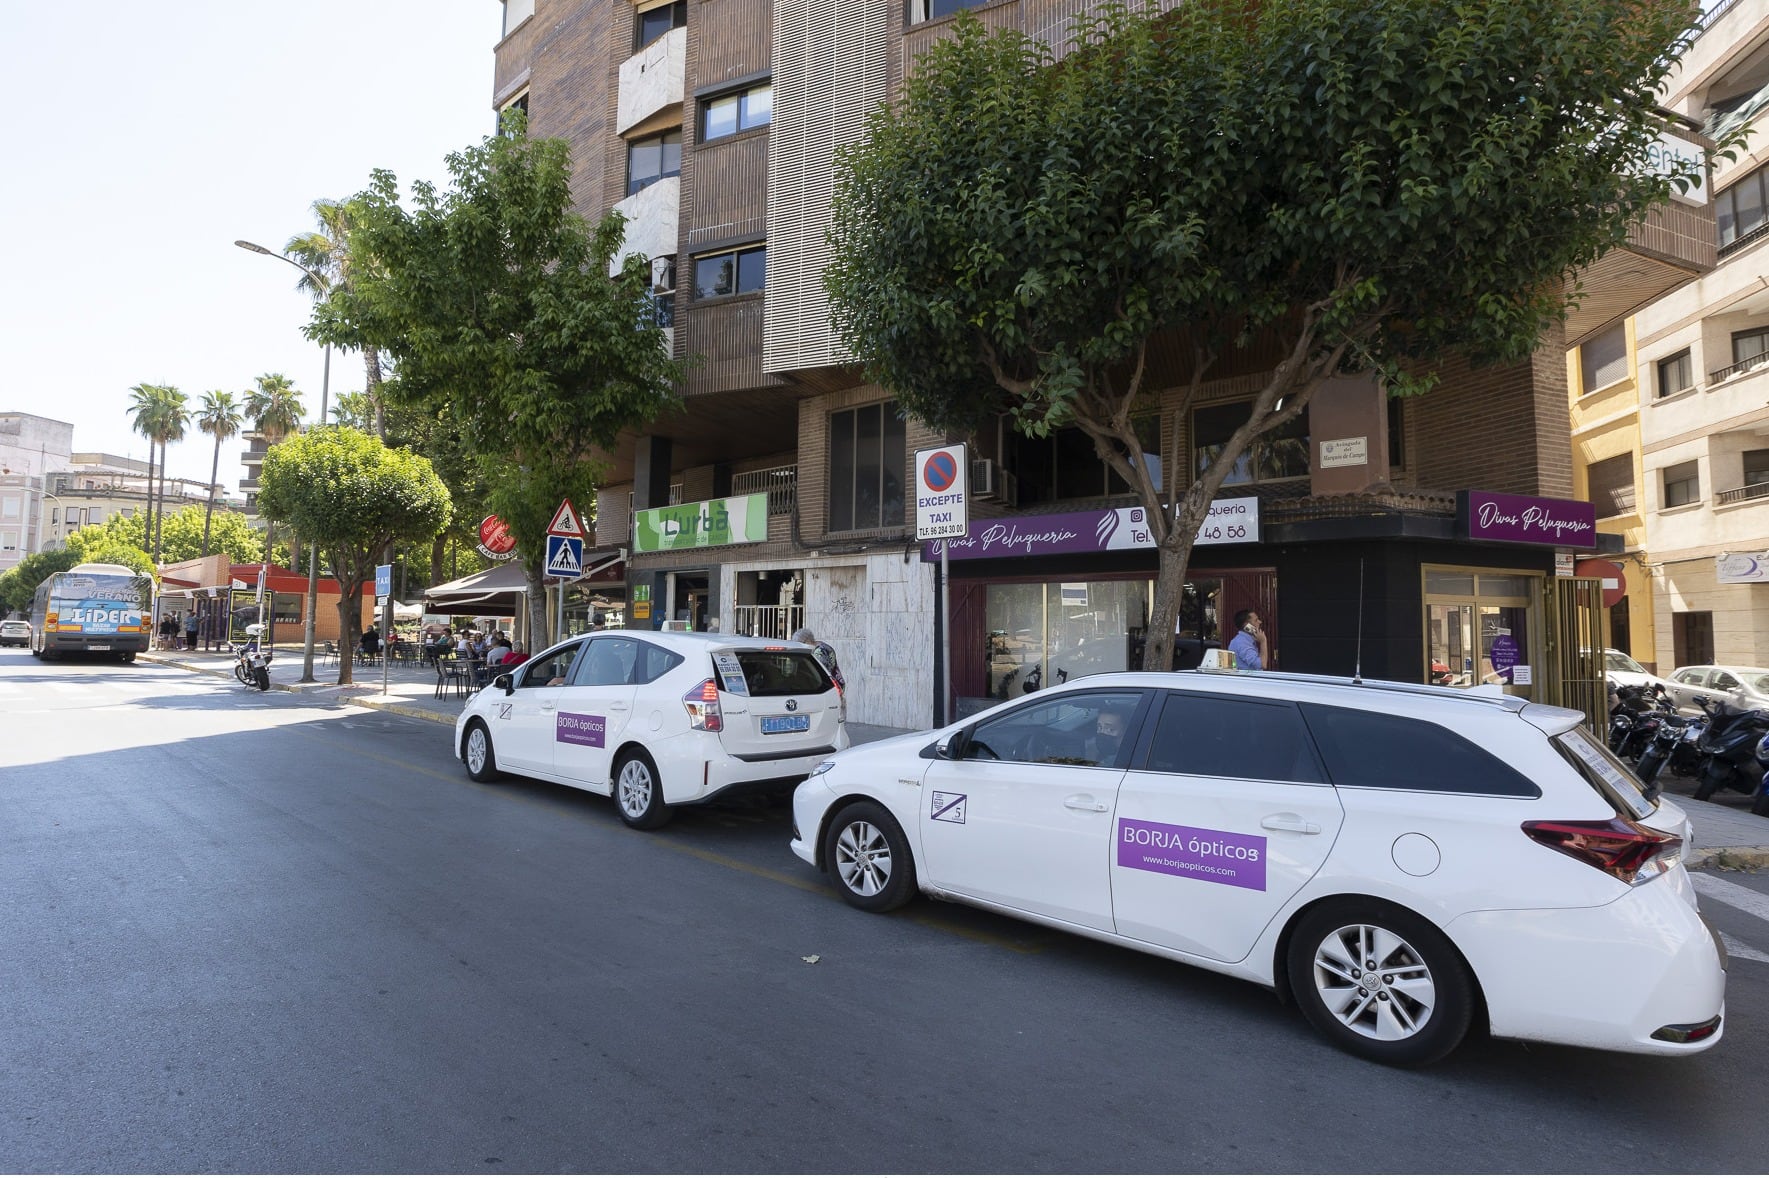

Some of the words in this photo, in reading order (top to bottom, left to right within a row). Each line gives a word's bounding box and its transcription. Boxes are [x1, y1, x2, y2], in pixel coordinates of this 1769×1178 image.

[1641, 144, 1699, 175] ental
[919, 493, 963, 508] EXCEPTE
[929, 512, 952, 523] TAXI
[1478, 502, 1519, 529] Divas
[930, 526, 937, 536] 96
[938, 525, 948, 535] 284
[949, 524, 956, 534] 30
[957, 524, 964, 533] 00
[1130, 529, 1150, 543] Tel.
[1204, 526, 1222, 539] 48
[1227, 525, 1246, 538] 58
[88, 590, 141, 603] VERANO
[558, 716, 579, 728] BORJA
[579, 719, 604, 732] ópticos
[954, 807, 961, 818] 5
[1124, 827, 1184, 850] BORJA
[1188, 836, 1260, 862] ópticos
[1142, 855, 1236, 877] www.borjaopticos.com
